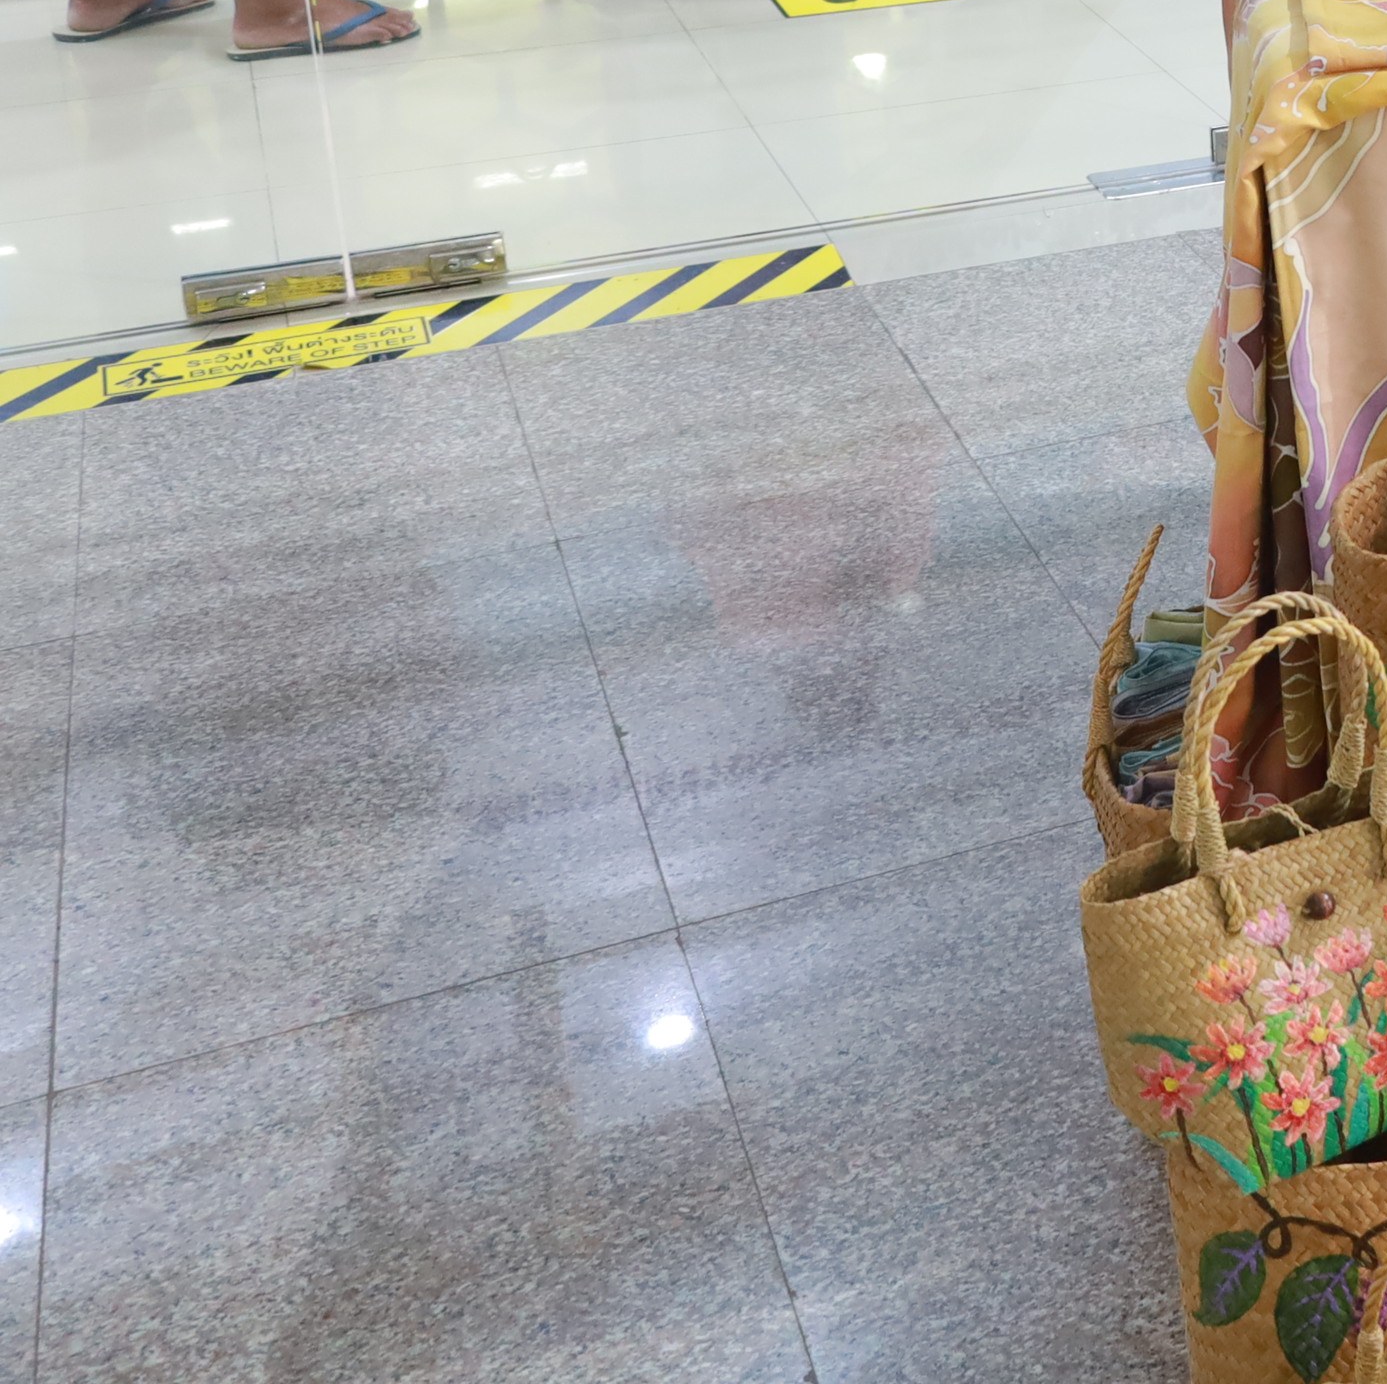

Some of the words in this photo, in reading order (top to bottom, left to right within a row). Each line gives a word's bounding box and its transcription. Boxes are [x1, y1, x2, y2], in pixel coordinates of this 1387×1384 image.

[186, 348, 254, 369] ระวัง!
[262, 324, 416, 355] พื้นต่างระดับ
[188, 353, 302, 379] BEWARE
[310, 345, 346, 360] OF
[351, 335, 417, 351] STEP
